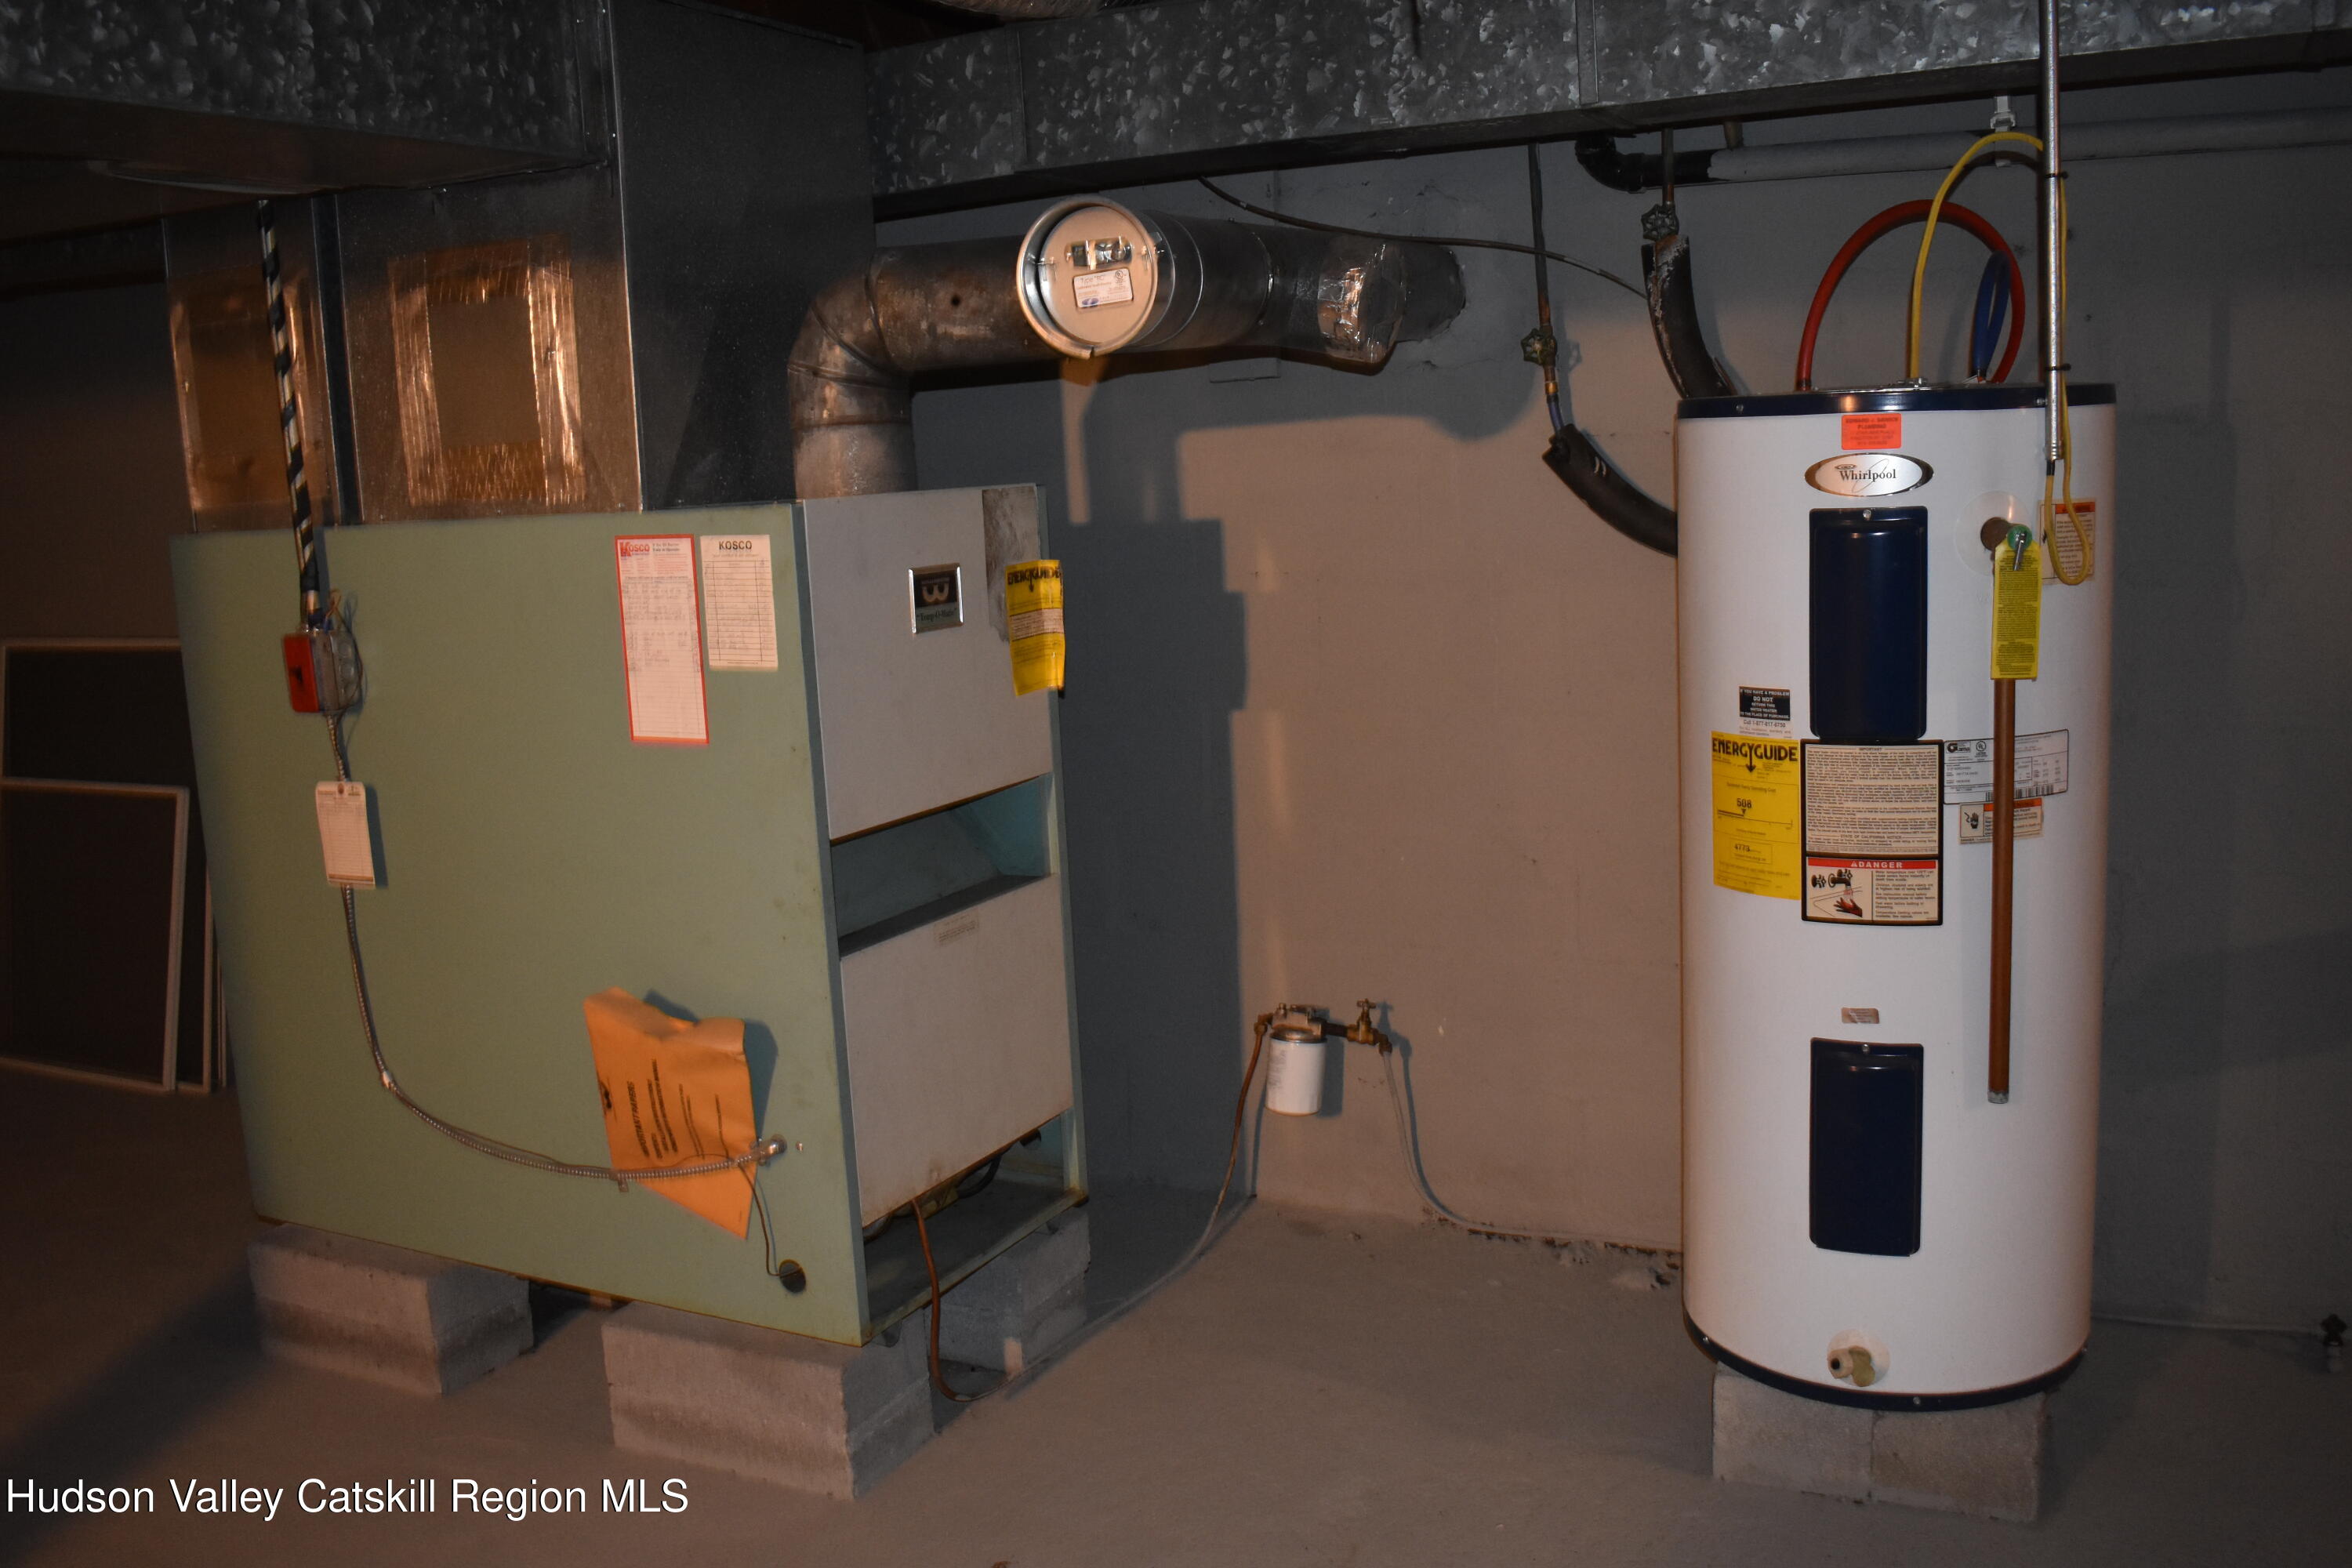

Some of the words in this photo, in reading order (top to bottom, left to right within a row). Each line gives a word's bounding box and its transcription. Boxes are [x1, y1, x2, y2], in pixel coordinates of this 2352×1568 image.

[1839, 469, 1896, 482] Whirlpool
[619, 541, 651, 557] KOSCO
[719, 540, 753, 550] KOSCO
[1711, 737, 1798, 762] ENERGYGUIDE
